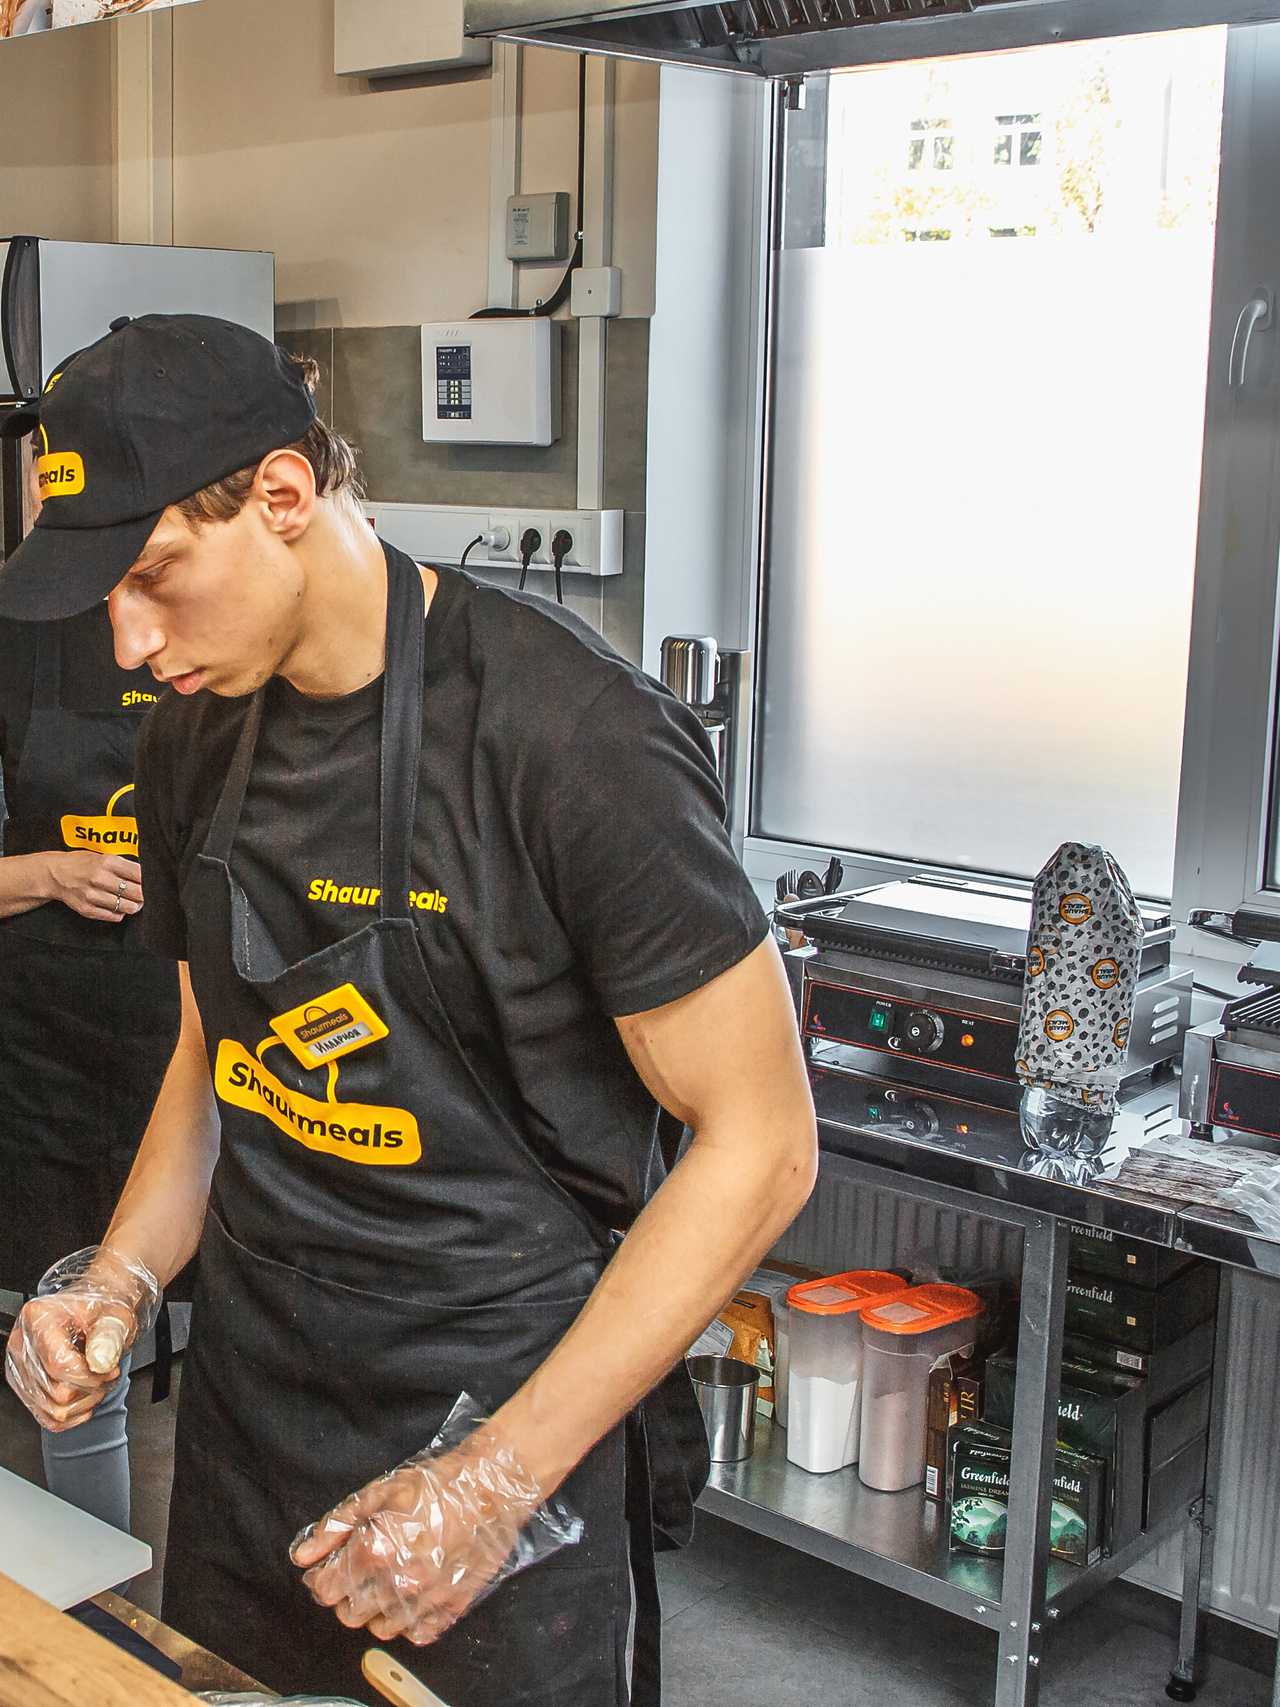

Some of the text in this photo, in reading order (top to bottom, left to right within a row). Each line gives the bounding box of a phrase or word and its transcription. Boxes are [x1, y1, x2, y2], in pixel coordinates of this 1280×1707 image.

[300, 1012, 349, 1040] Shaurmeals
[228, 1061, 404, 1149] Shaurmeals
[1070, 1225, 1113, 1242] reenfield
